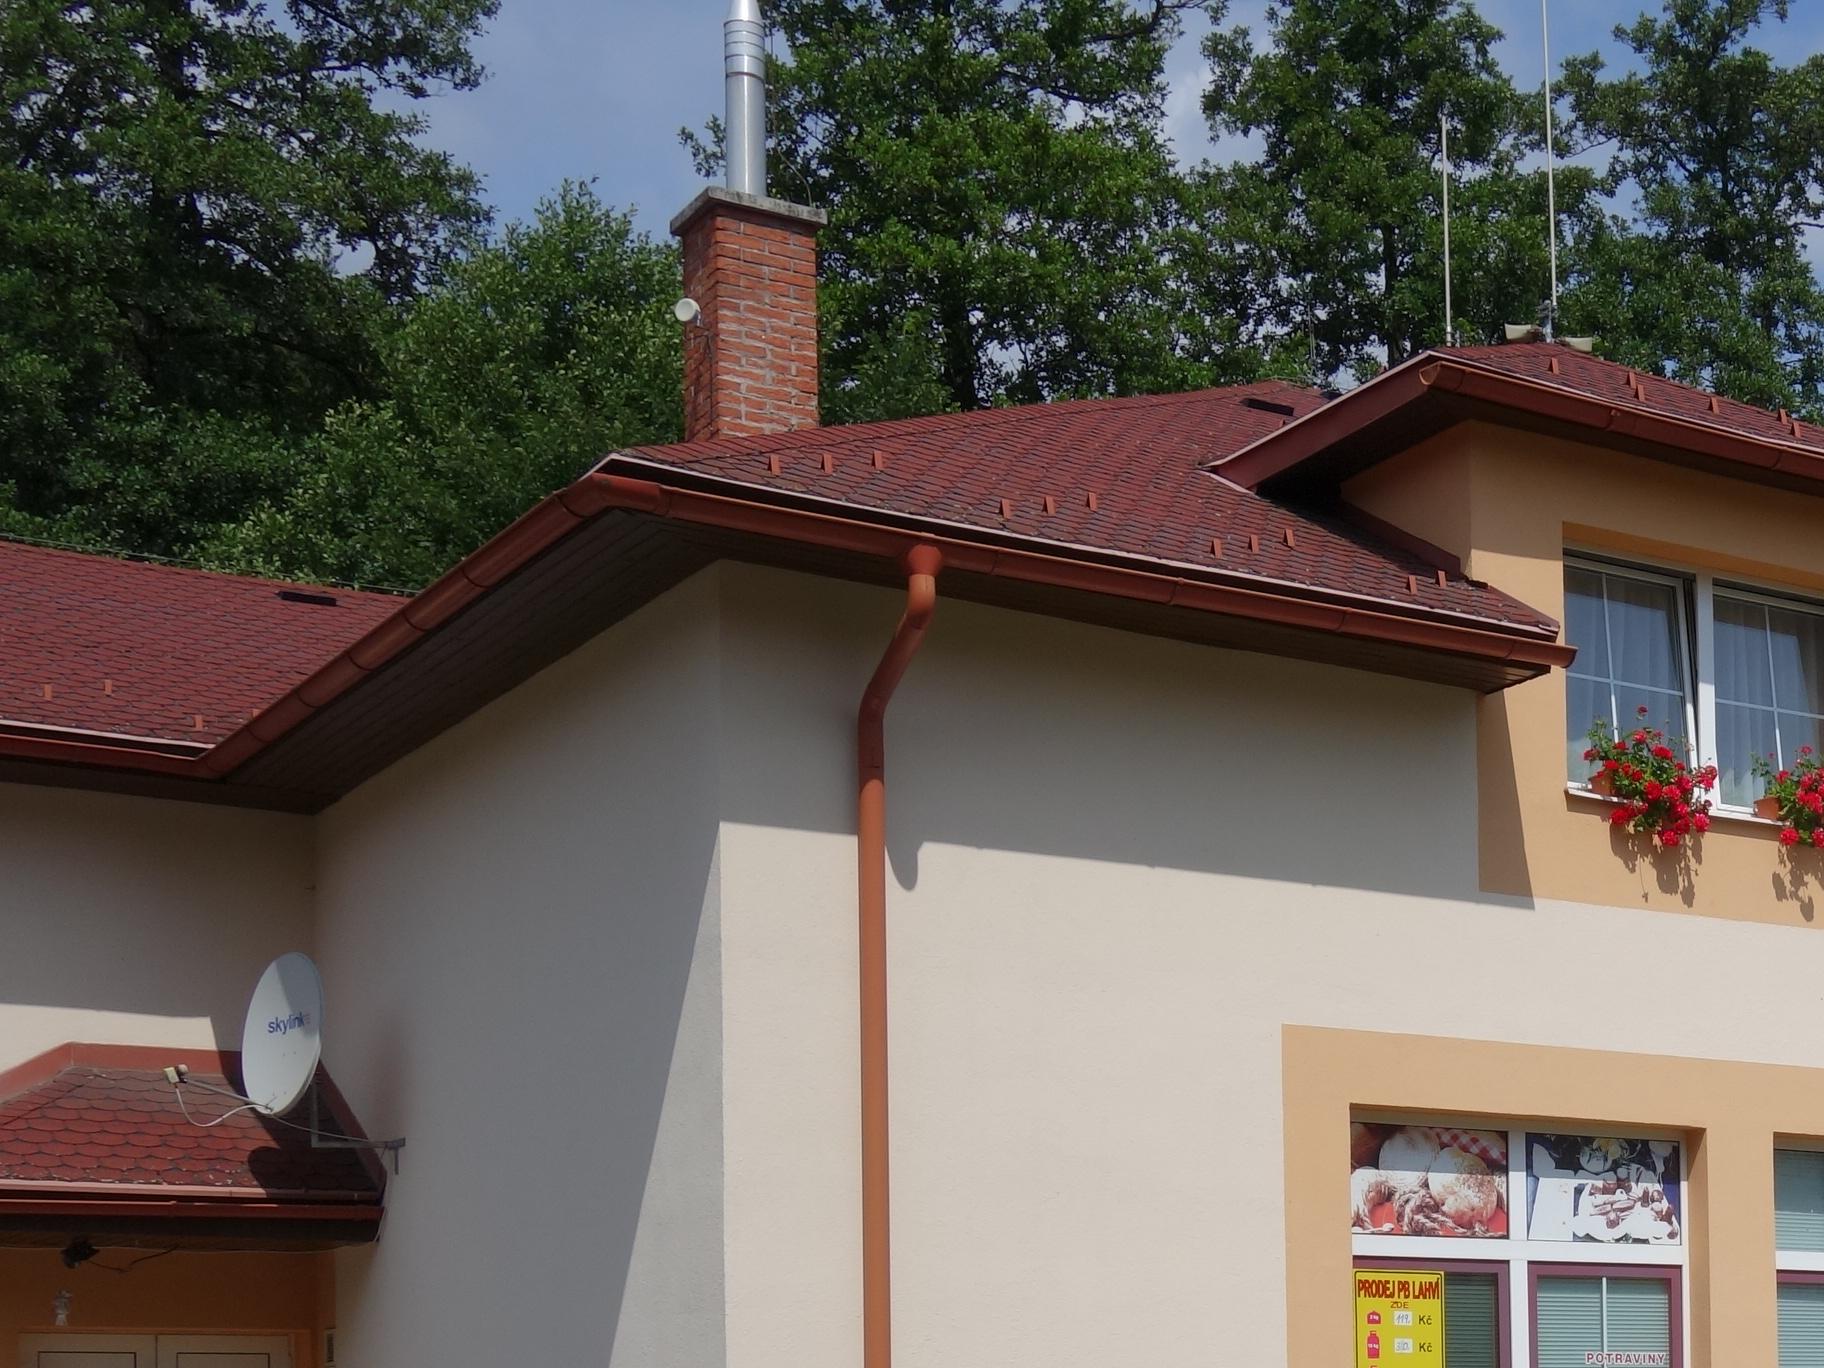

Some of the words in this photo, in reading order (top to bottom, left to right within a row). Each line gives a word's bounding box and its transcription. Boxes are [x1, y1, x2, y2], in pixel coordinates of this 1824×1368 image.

[267, 1011, 305, 1035] skylink
[1357, 1279, 1396, 1299] PRODEJ
[1397, 1280, 1411, 1299] PB
[1412, 1277, 1440, 1300] LAHVÍ
[1390, 1301, 1409, 1309] ZDE
[1418, 1314, 1433, 1325] Kč
[1418, 1342, 1433, 1353] Kč
[1585, 1351, 1666, 1365] POTRAVINY
